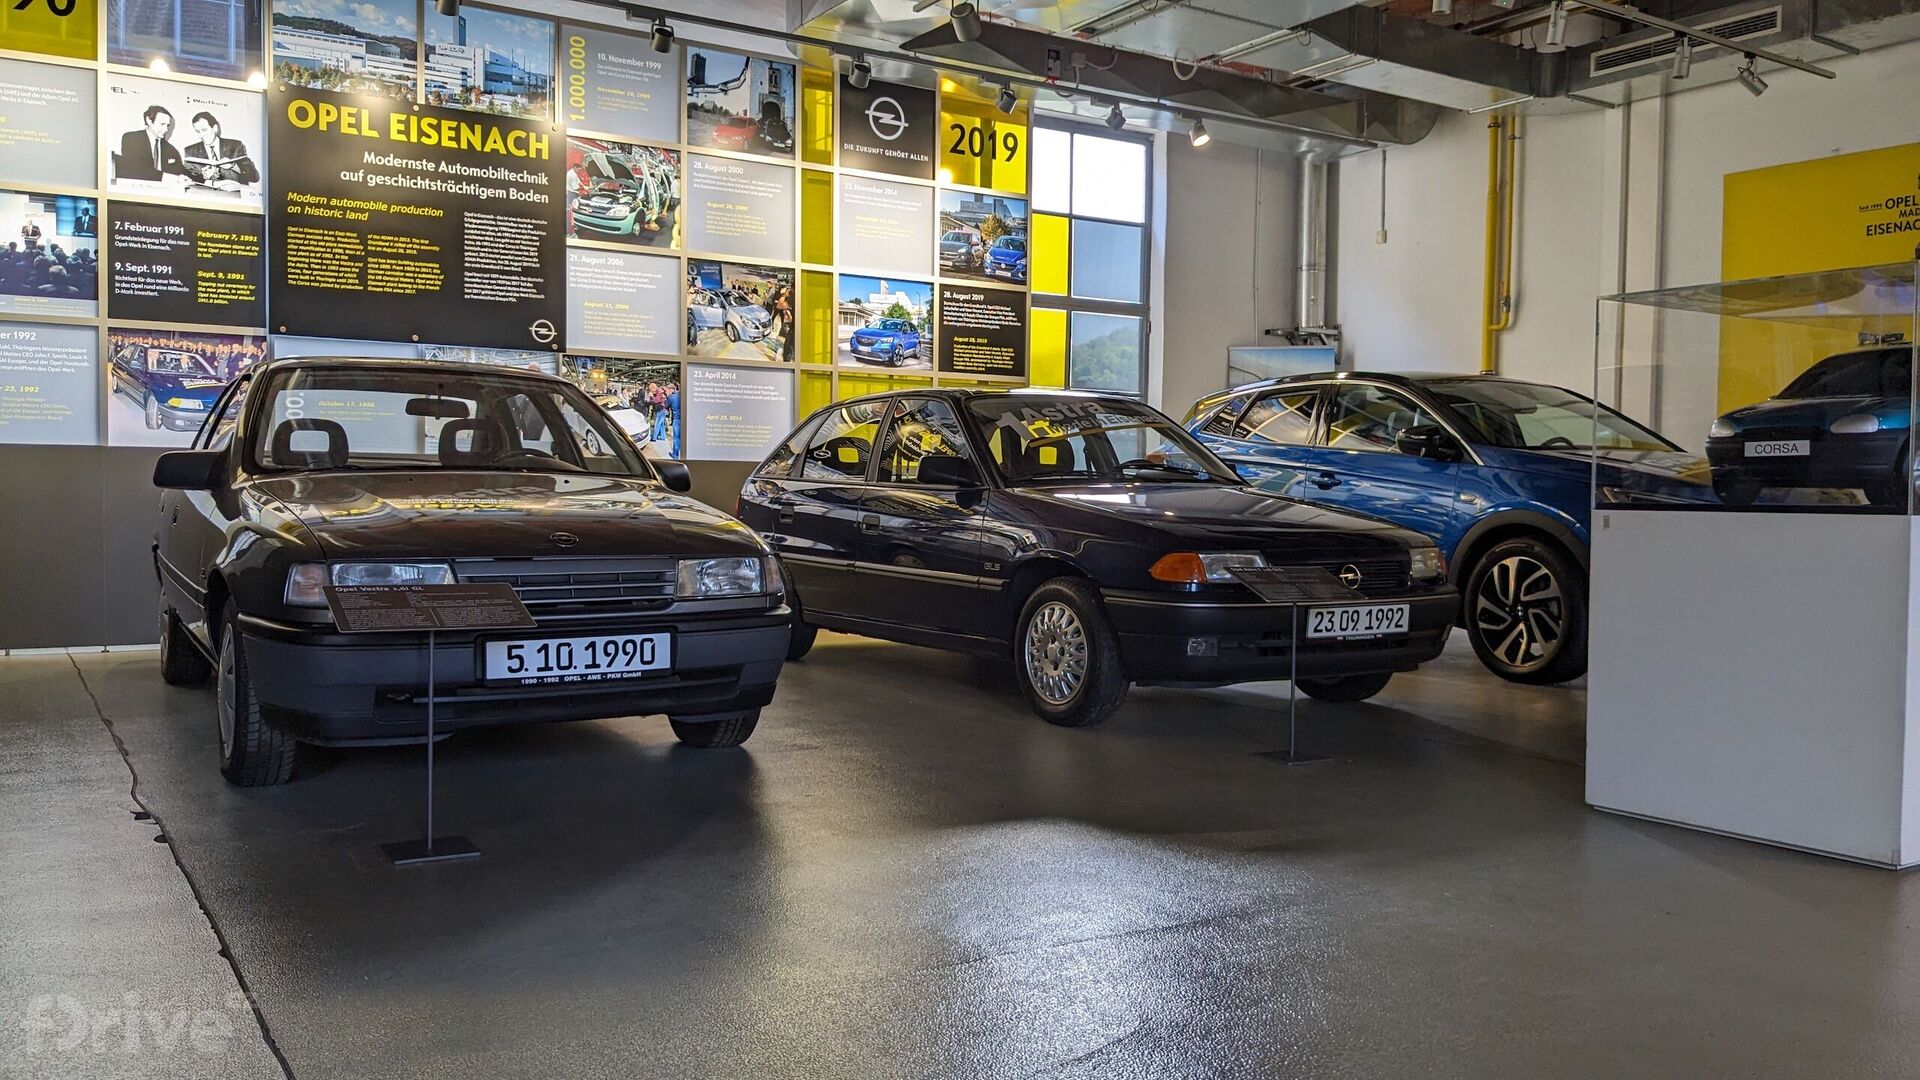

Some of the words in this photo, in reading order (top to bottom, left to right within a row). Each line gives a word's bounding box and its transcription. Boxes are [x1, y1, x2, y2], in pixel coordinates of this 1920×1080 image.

[597, 53, 607, 61] 10.
[609, 56, 644, 68] November
[646, 61, 661, 69] 1999
[569, 36, 585, 120] 1.000.000
[288, 100, 379, 138] OPEL
[390, 112, 549, 160] EISENACH
[950, 124, 1018, 162] 2019
[856, 144, 883, 155] ZUKUNFT
[885, 149, 908, 159] GEHÖRT
[910, 153, 929, 162] ALLEN
[363, 151, 436, 172] Modernste
[439, 160, 549, 185] Automobiltechnik
[705, 163, 727, 173] August
[728, 166, 744, 174] 2000
[340, 170, 364, 182] auf
[367, 172, 507, 199] geschichtsträchtigem
[510, 188, 549, 204] Boden
[288, 192, 327, 204] Modern
[330, 196, 388, 211] automobile
[390, 204, 444, 217] production
[1885, 195, 1919, 209] OPEL
[304, 206, 343, 218] historic
[346, 208, 368, 221] land
[115, 221, 122, 230] 7.
[125, 222, 162, 232] Februar
[164, 226, 184, 235] 1991
[197, 231, 230, 239] February
[115, 262, 124, 270] 9.
[126, 263, 150, 273] Sept.
[152, 265, 172, 274] 1991
[581, 256, 605, 264] August
[608, 258, 624, 266] 2006
[953, 292, 970, 300] August
[14, 331, 36, 340] 1992
[705, 372, 720, 380] April
[1020, 401, 1105, 425] Astra
[1754, 443, 1799, 454] CORSA
[984, 562, 1000, 570] GLS
[1313, 607, 1404, 633] 23.09.1992
[507, 638, 656, 674] 5.10.1990
